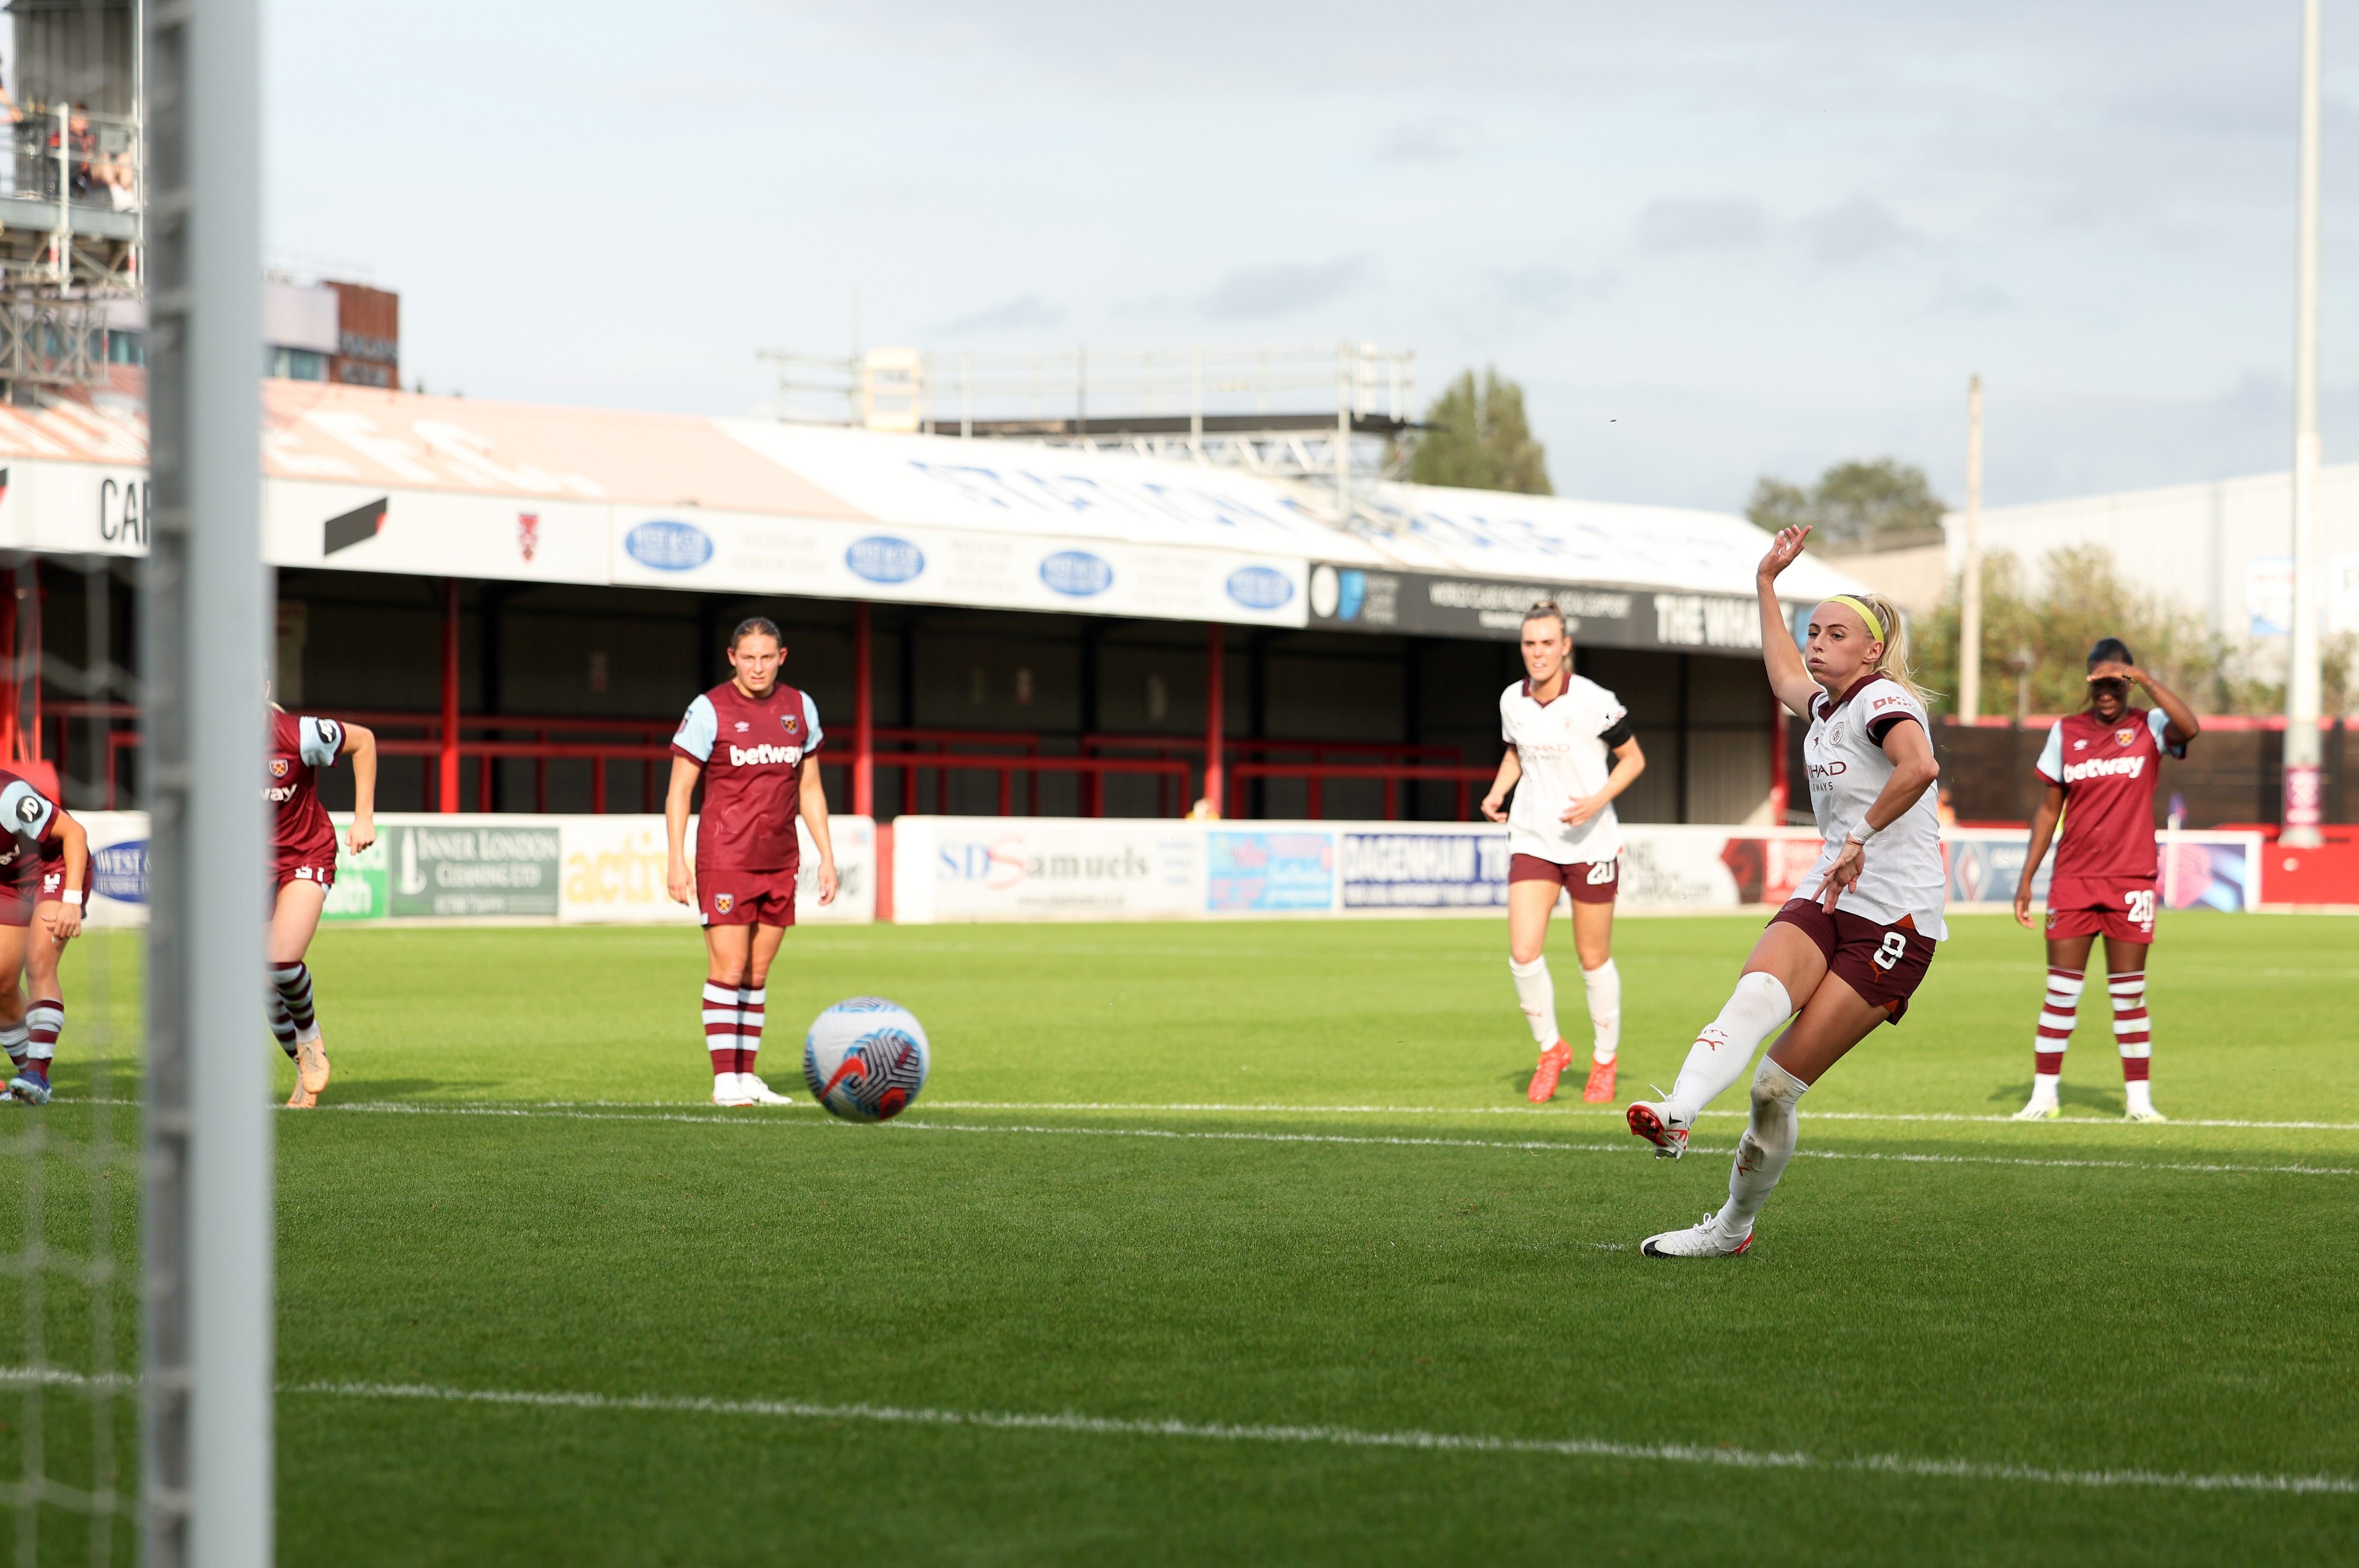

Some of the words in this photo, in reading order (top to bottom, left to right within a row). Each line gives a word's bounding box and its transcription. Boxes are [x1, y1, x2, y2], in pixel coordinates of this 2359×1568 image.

[729, 743, 803, 768] betway
[2063, 755, 2145, 784] betway
[1810, 782, 1833, 792] IRWAYS
[22, 797, 39, 823] JD
[479, 829, 558, 861] LONDON
[2124, 890, 2155, 922] 20
[1873, 932, 1907, 970] 8
